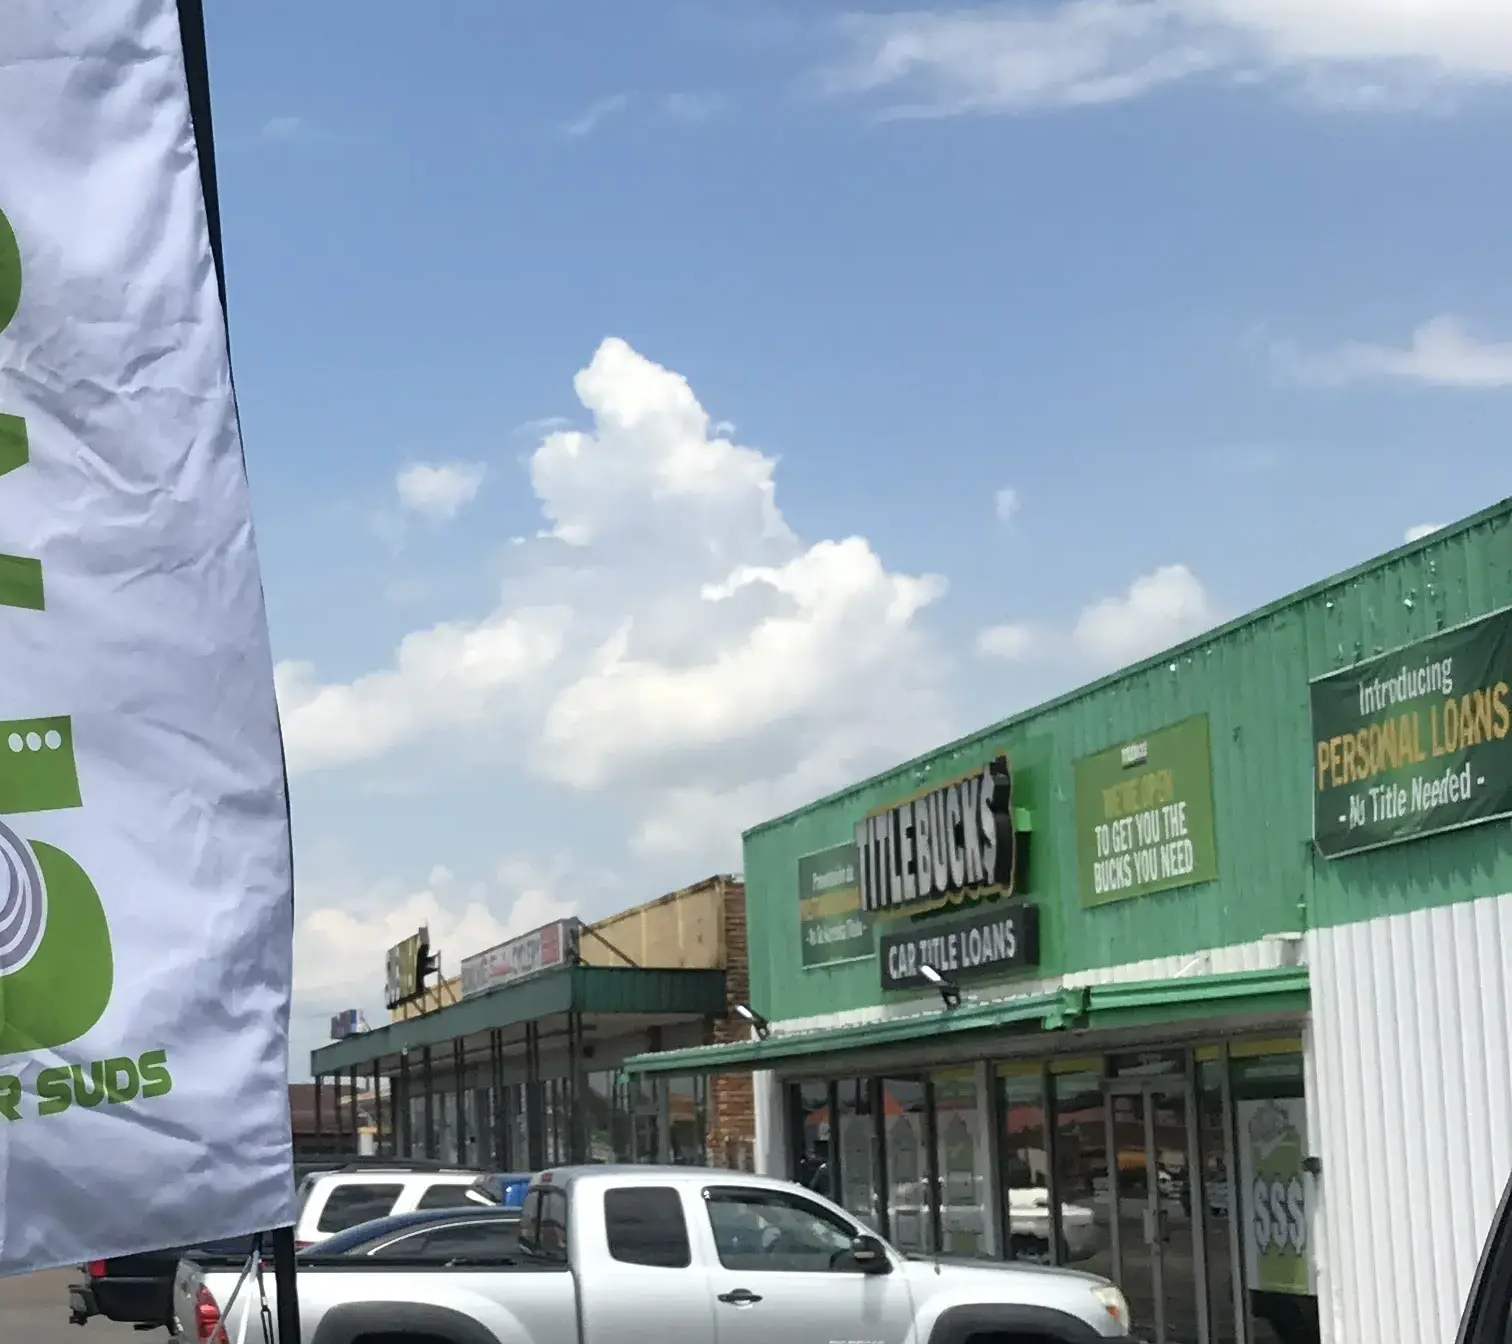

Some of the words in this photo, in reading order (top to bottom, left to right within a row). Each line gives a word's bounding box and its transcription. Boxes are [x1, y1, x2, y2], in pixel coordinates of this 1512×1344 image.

[1359, 656, 1453, 716] Introducing
[1317, 711, 1426, 791] PERSONAL
[1431, 681, 1510, 756] LOANS
[1369, 783, 1407, 822] Title
[1411, 762, 1472, 812] Needed
[1095, 824, 1110, 857] TO
[1112, 816, 1133, 853] GET
[1135, 809, 1160, 846] YOU
[1162, 801, 1188, 839] THE
[1093, 854, 1132, 894] BUCKS
[1133, 848, 1158, 884] YOU
[1160, 838, 1194, 878] NEED
[888, 943, 917, 980] CAR
[919, 933, 958, 972] TITLE
[960, 918, 1016, 968] LOANS
[36, 1049, 173, 1116] SUDS
